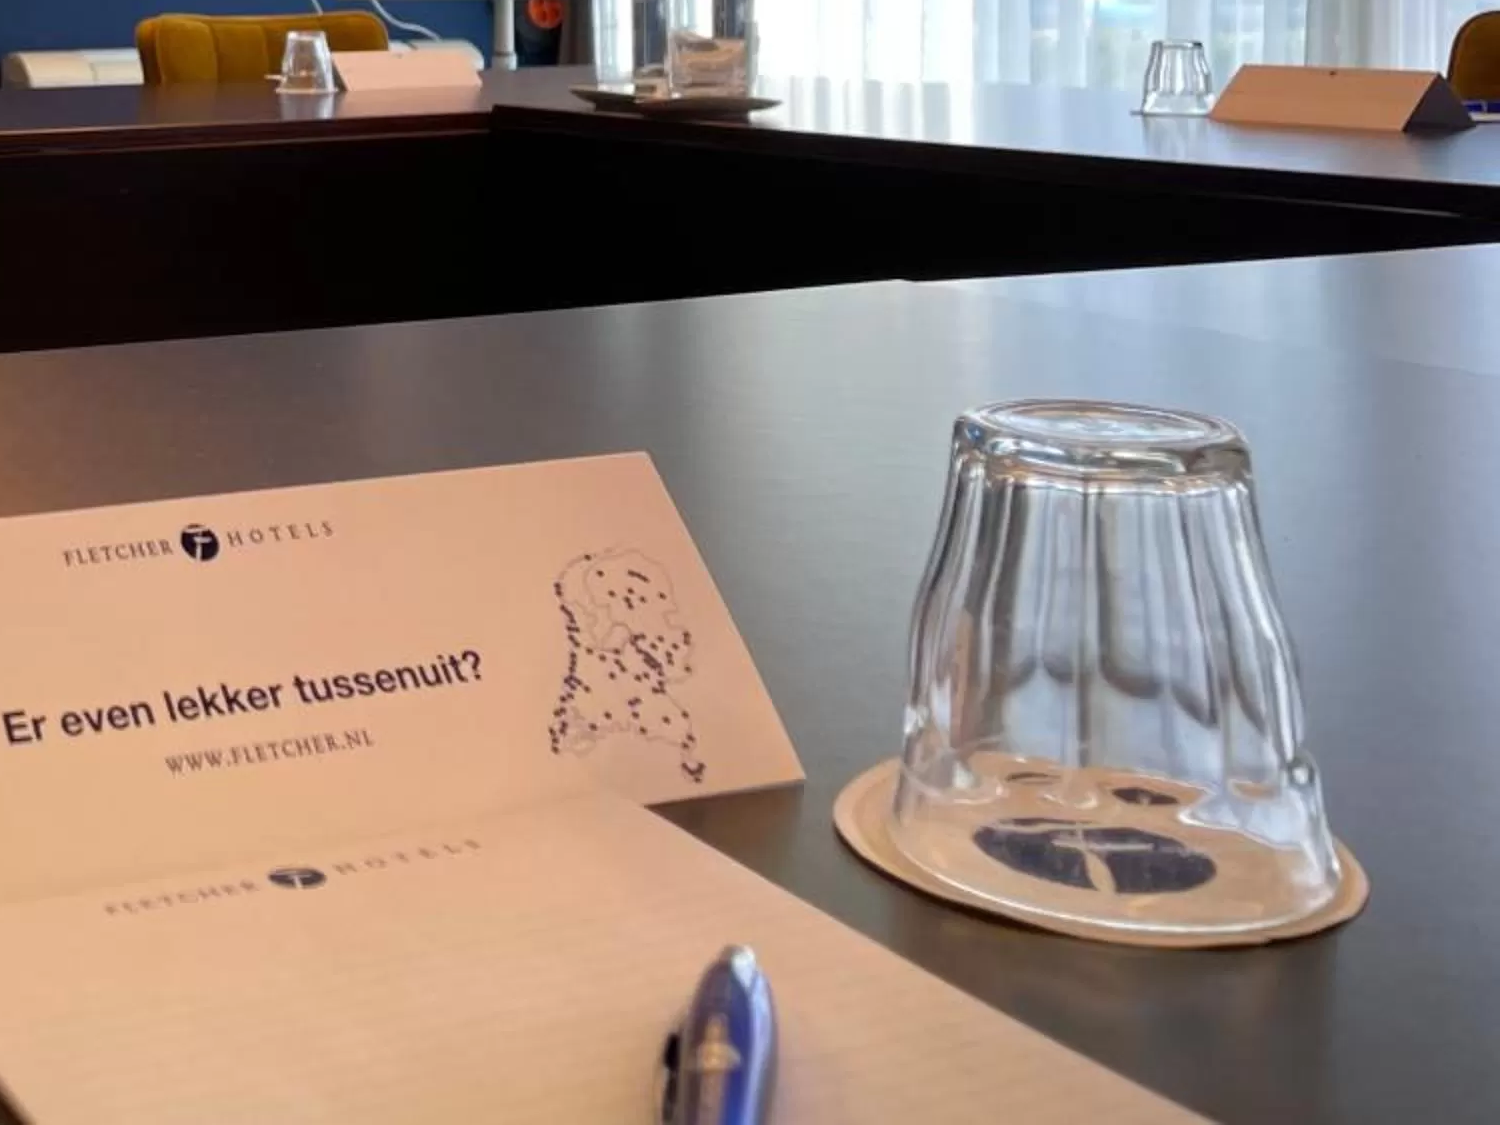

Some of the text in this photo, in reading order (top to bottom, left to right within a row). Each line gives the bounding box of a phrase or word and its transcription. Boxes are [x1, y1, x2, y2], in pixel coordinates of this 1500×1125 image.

[63, 538, 174, 568] FLETCHER
[225, 519, 335, 549] HOTELS
[2, 649, 484, 745] Er even lekker tussenuit?
[164, 728, 376, 777] WWW.FLETCHER.NL
